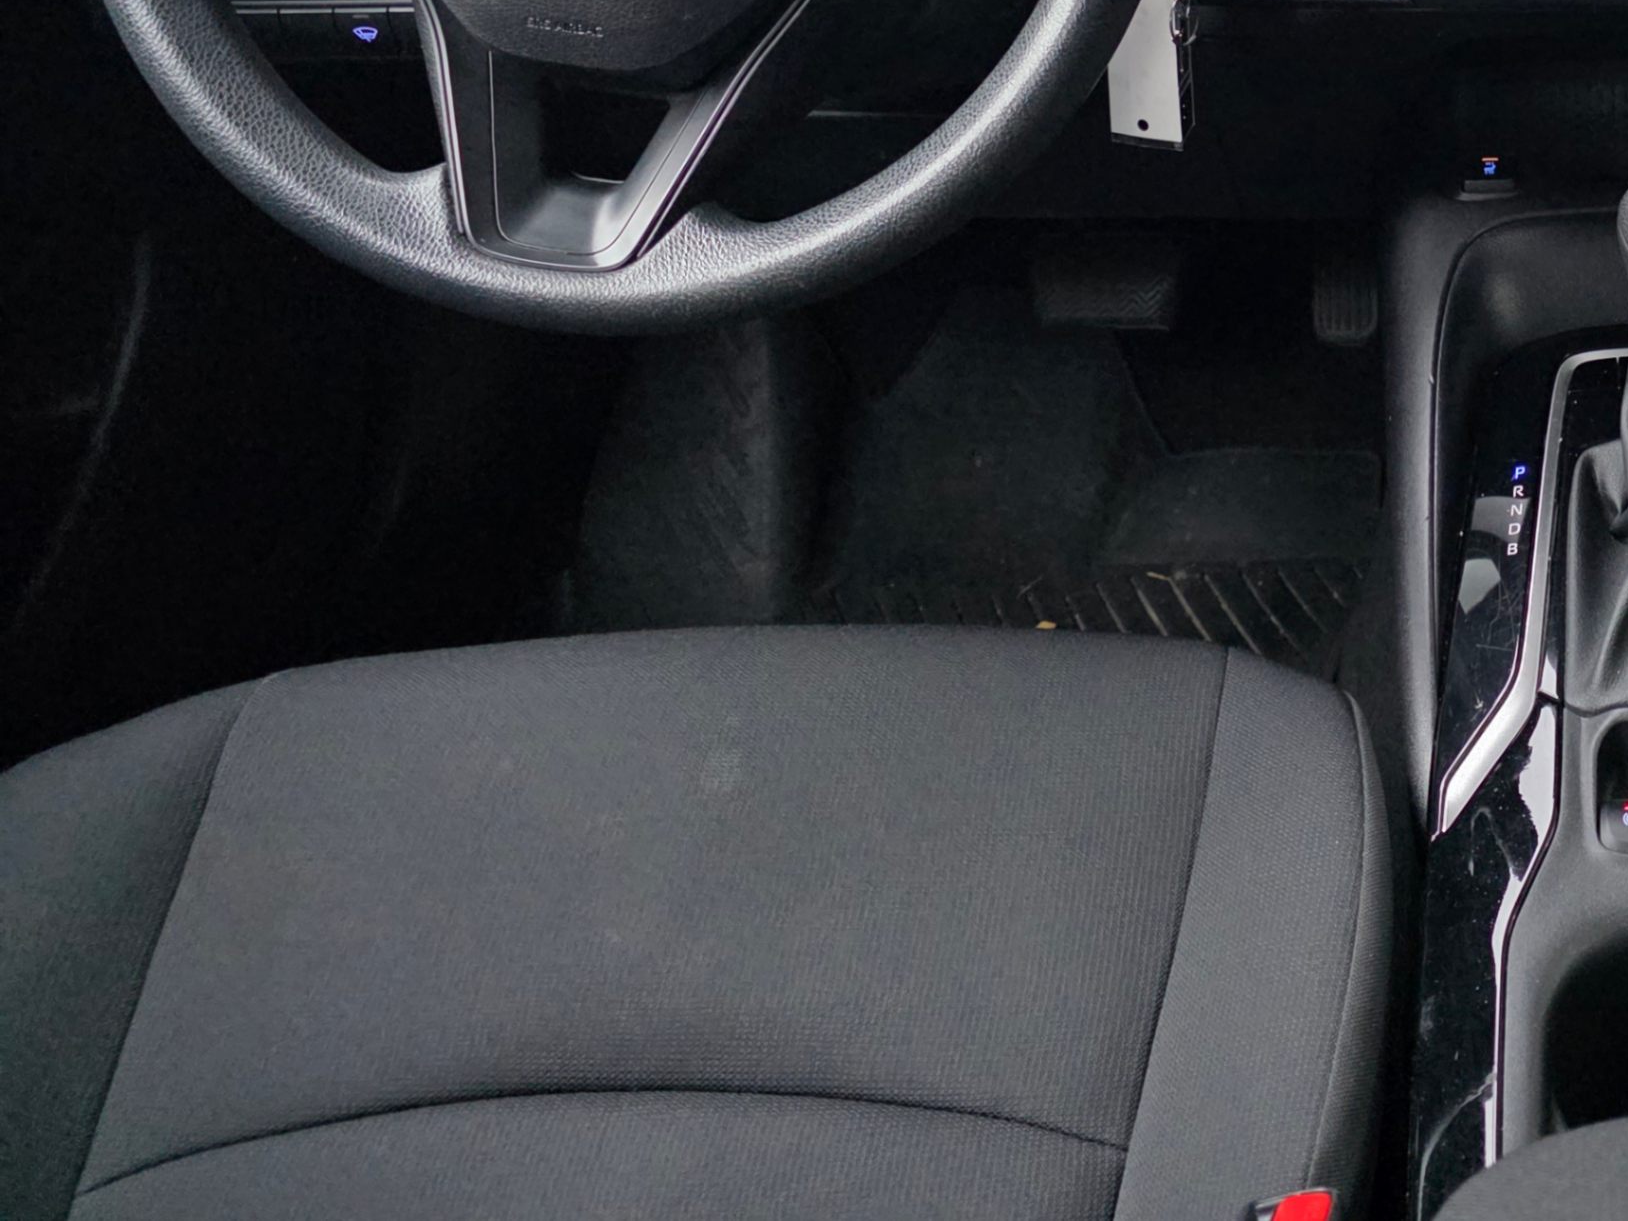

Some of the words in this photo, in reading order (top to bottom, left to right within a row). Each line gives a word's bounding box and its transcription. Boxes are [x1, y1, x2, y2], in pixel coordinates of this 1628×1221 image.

[1514, 466, 1526, 480] P
[1513, 485, 1524, 498] R
[1510, 503, 1523, 517] N
[1508, 523, 1520, 535] D
[1507, 543, 1518, 556] B
